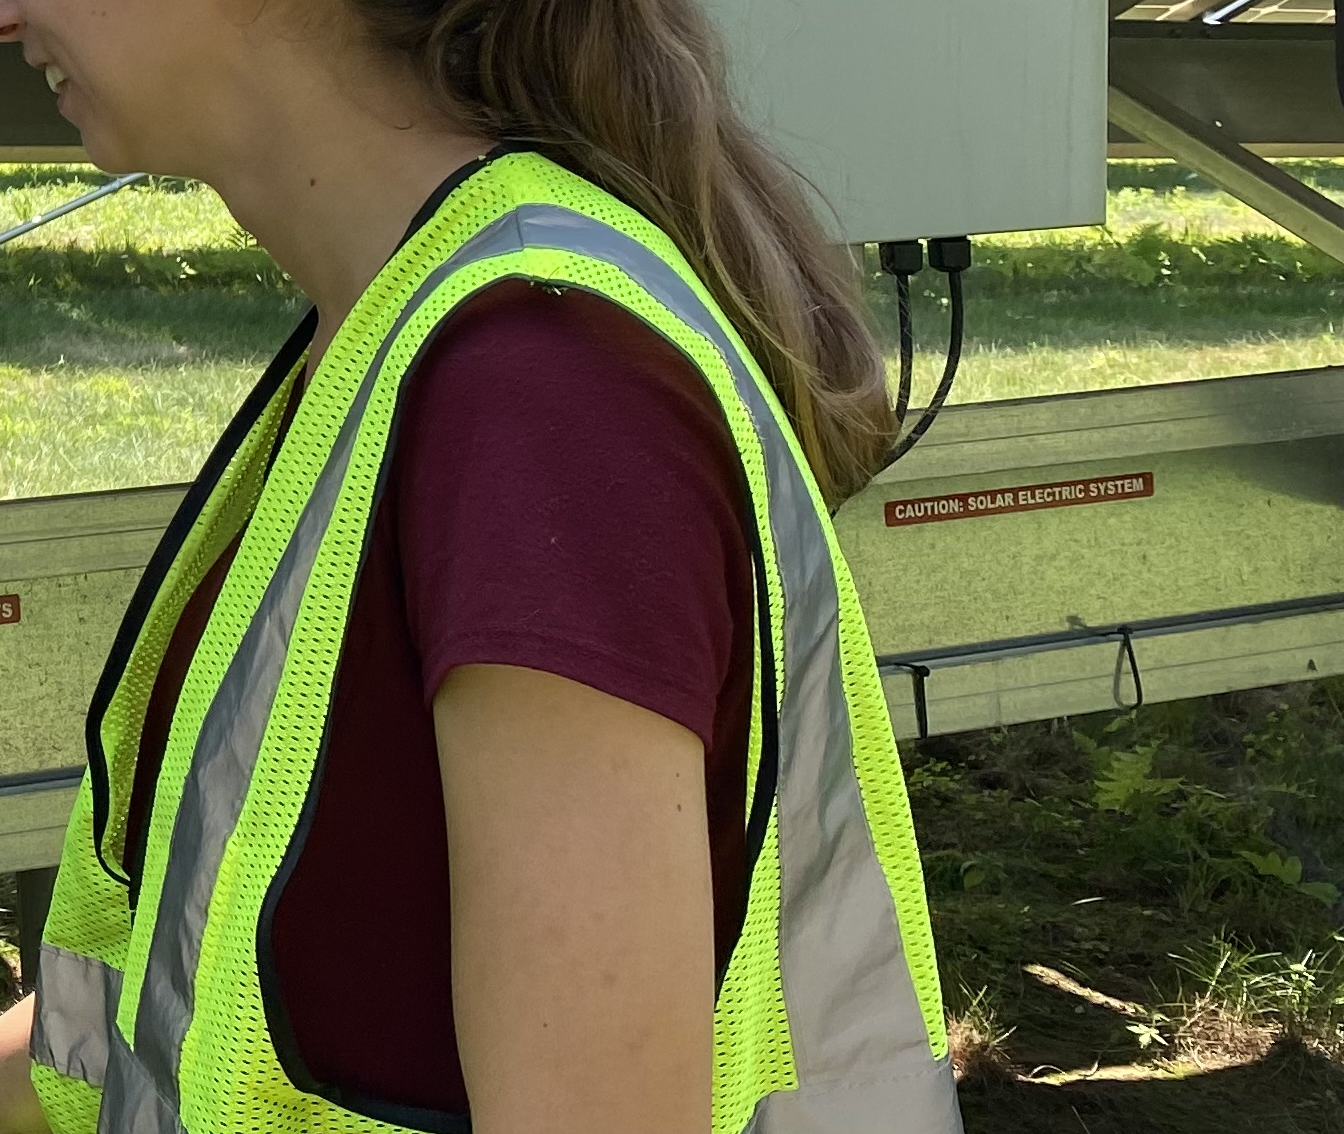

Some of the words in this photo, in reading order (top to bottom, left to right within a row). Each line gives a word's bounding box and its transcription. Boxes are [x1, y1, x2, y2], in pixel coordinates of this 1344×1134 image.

[895, 498, 964, 519] CAUTION:
[967, 492, 1014, 511] SOLAR
[1018, 484, 1085, 505] ELECTRIC
[1088, 477, 1145, 497] SYSTEM
